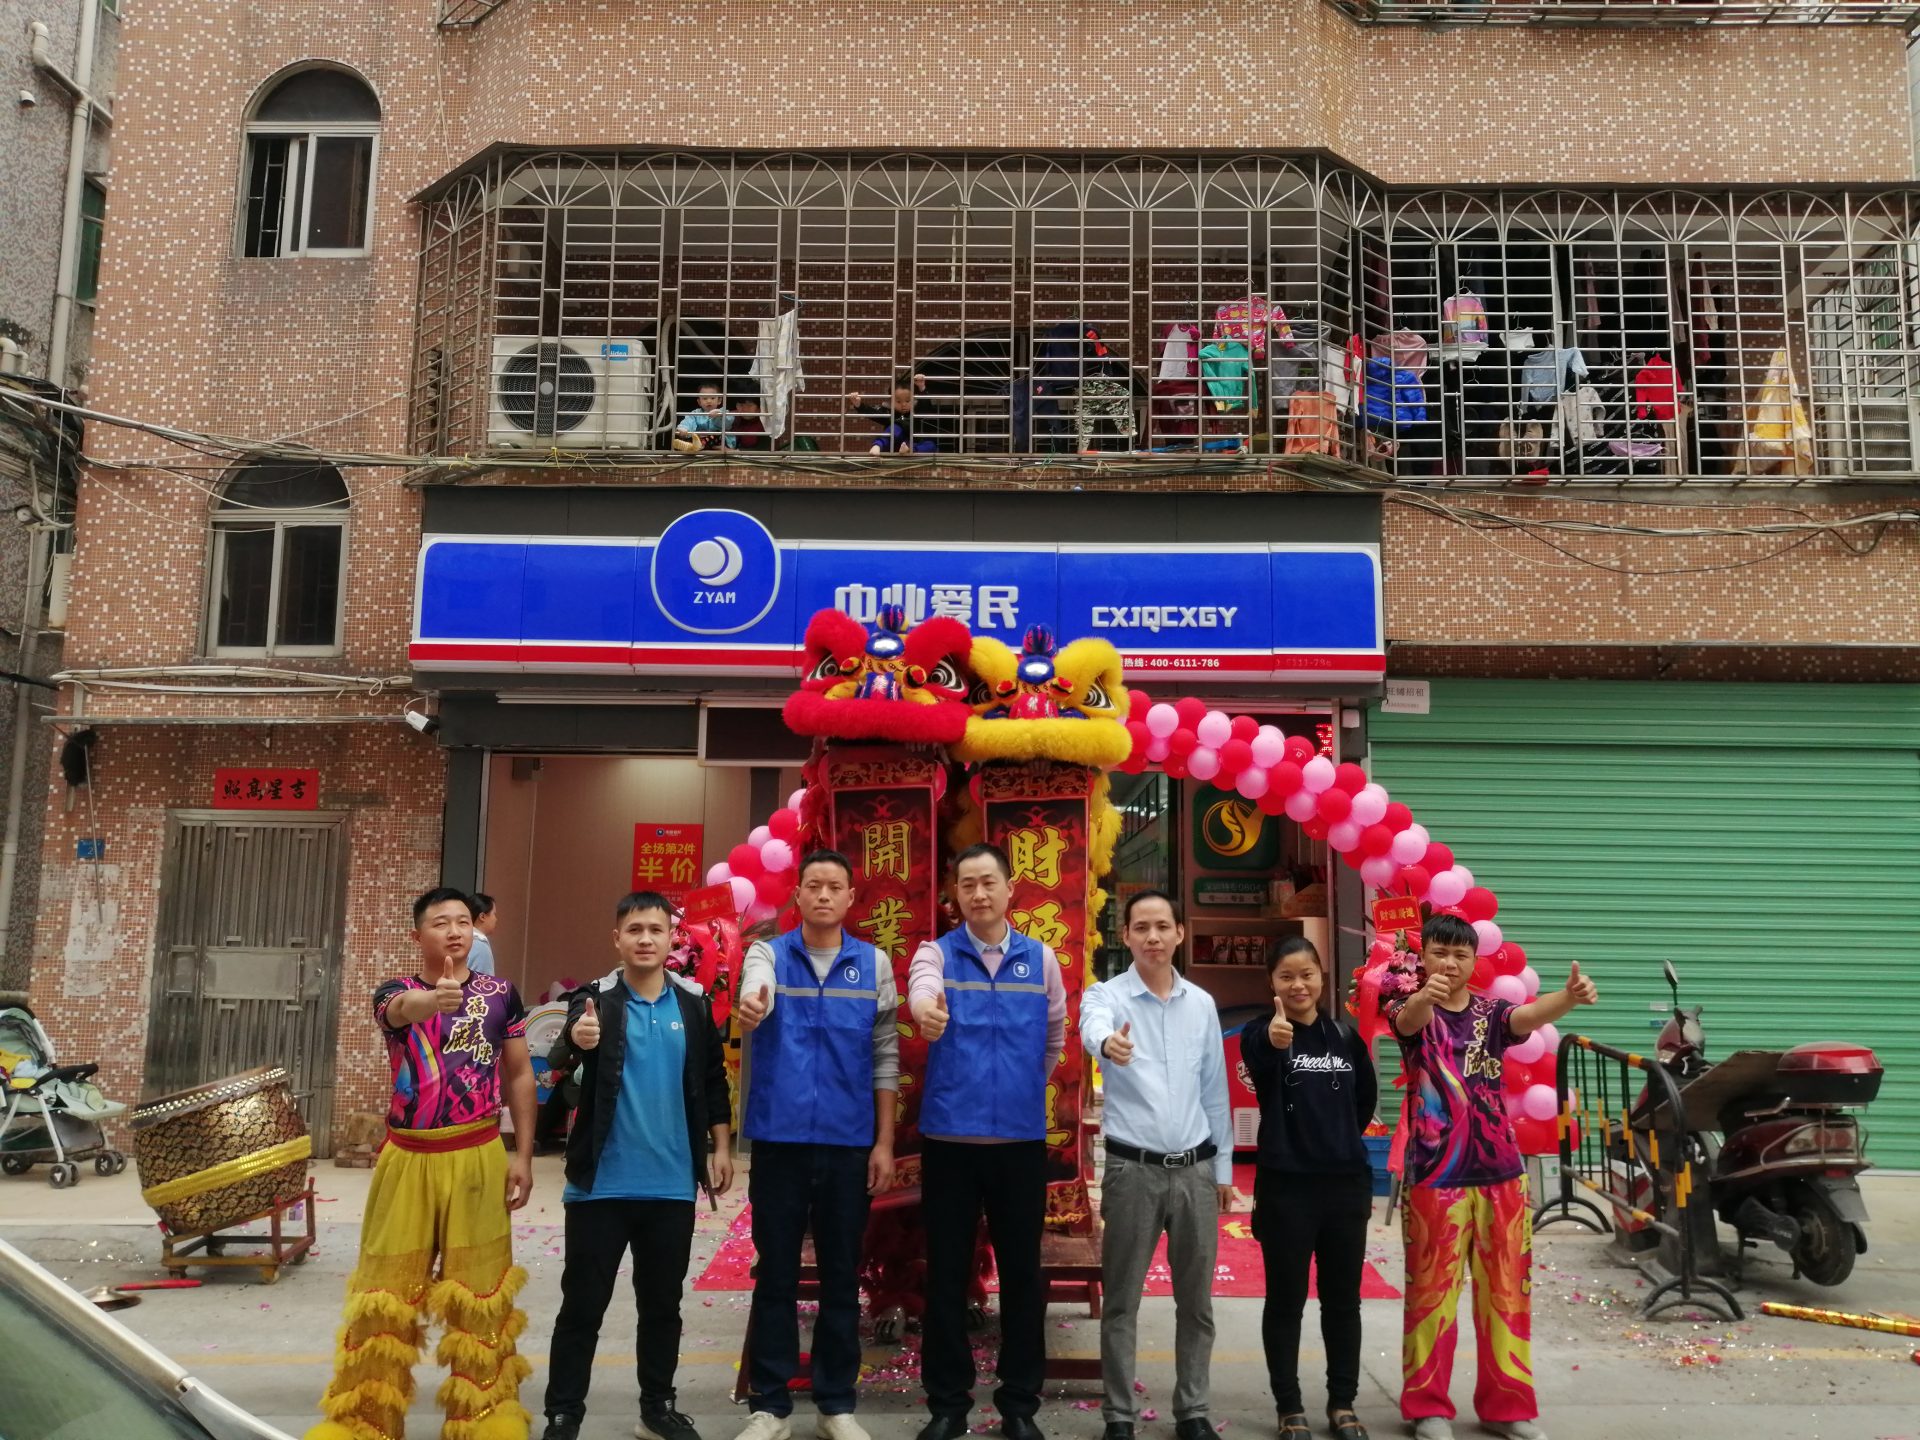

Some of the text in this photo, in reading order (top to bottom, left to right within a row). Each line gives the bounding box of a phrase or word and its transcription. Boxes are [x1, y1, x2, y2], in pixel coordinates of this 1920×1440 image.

[693, 591, 736, 604] ZYAM
[1091, 606, 1238, 633] CXJQCXGY
[640, 842, 696, 855] 全场第2件
[637, 857, 696, 883] 半价
